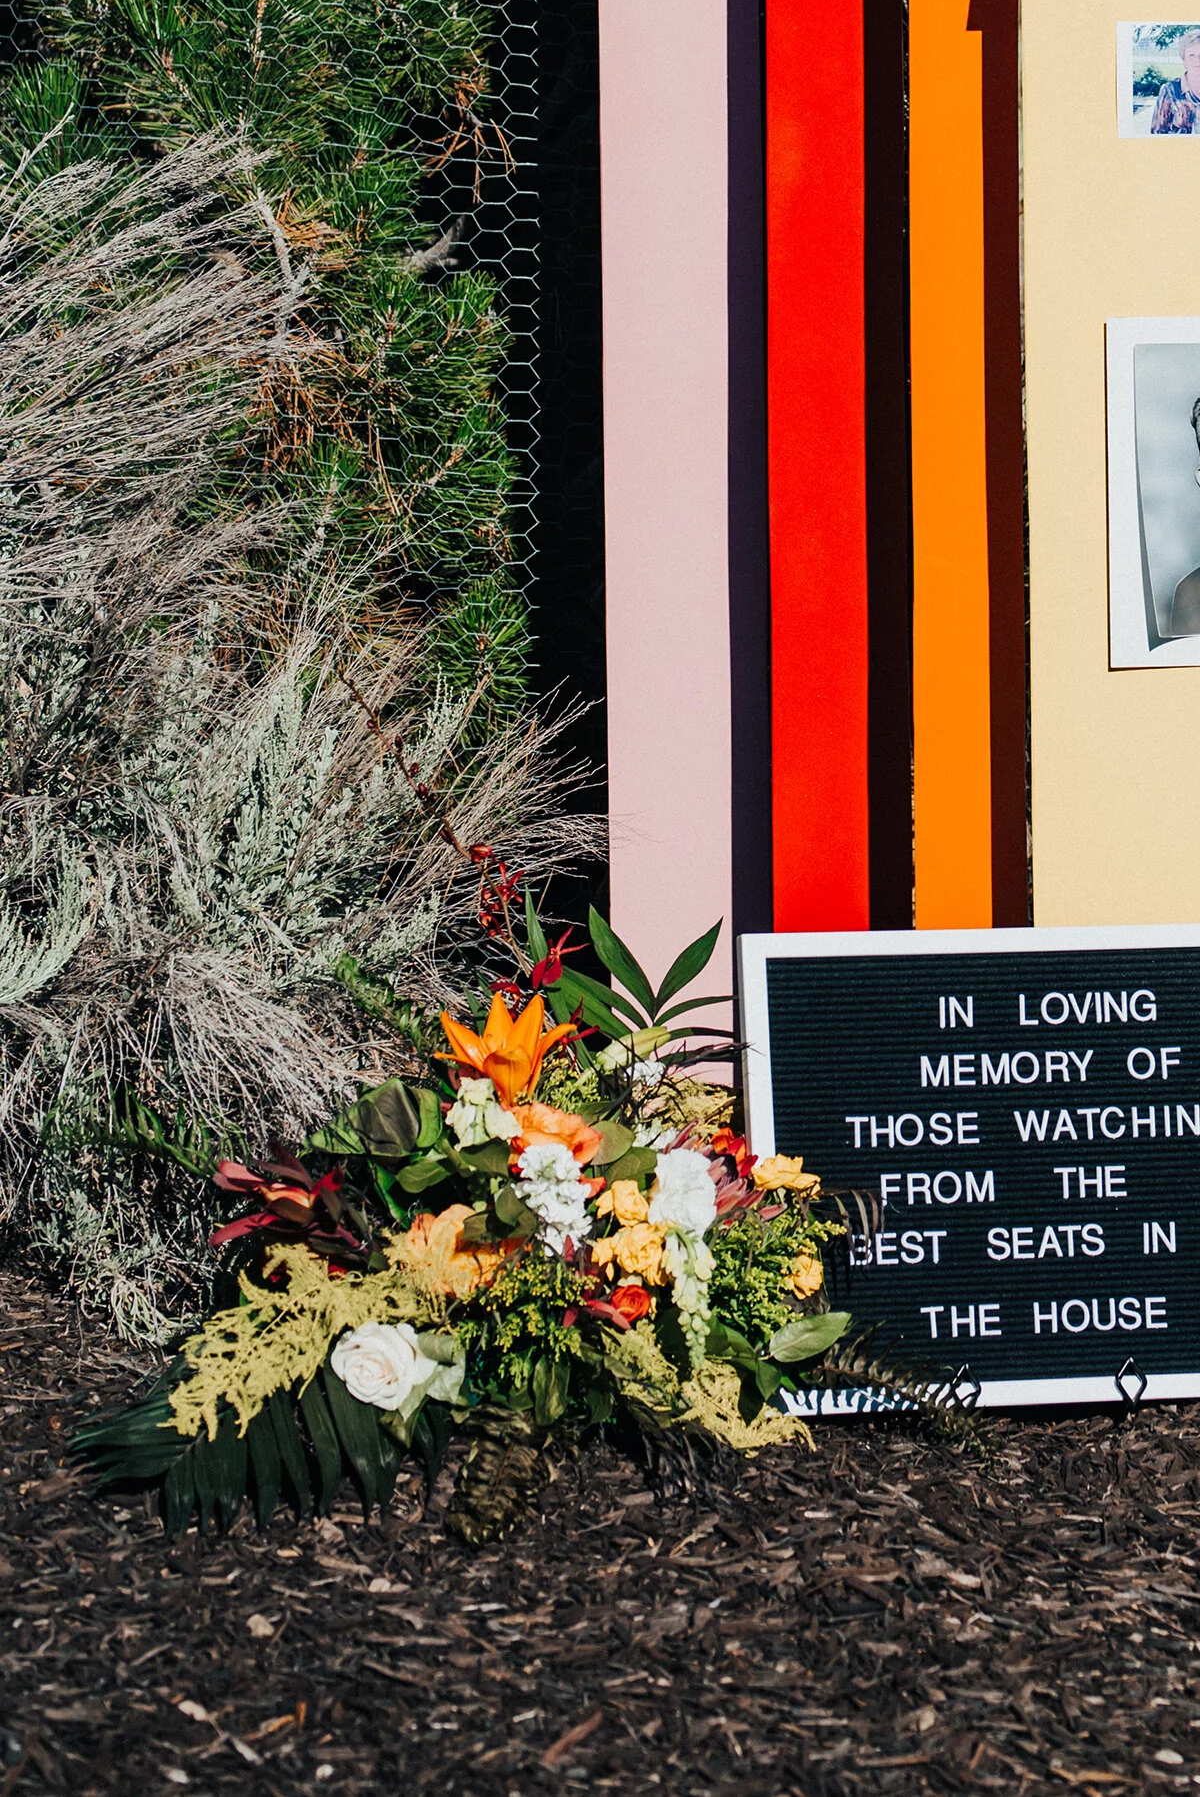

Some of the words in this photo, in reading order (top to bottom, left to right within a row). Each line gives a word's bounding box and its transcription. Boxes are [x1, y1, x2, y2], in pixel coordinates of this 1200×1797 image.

[940, 996, 974, 1028] IN
[1018, 989, 1157, 1026] LOVING
[920, 1049, 1094, 1088] MEMORY
[1127, 1046, 1181, 1080] OF
[845, 1112, 980, 1148] THOSE
[880, 1170, 996, 1206] FROM
[1054, 1165, 1128, 1199] THE
[850, 1230, 948, 1266] BEST
[986, 1223, 1106, 1260] SEATS
[1143, 1221, 1177, 1255] IN
[920, 1304, 1002, 1338] THE
[1033, 1296, 1168, 1334] HOUSE
